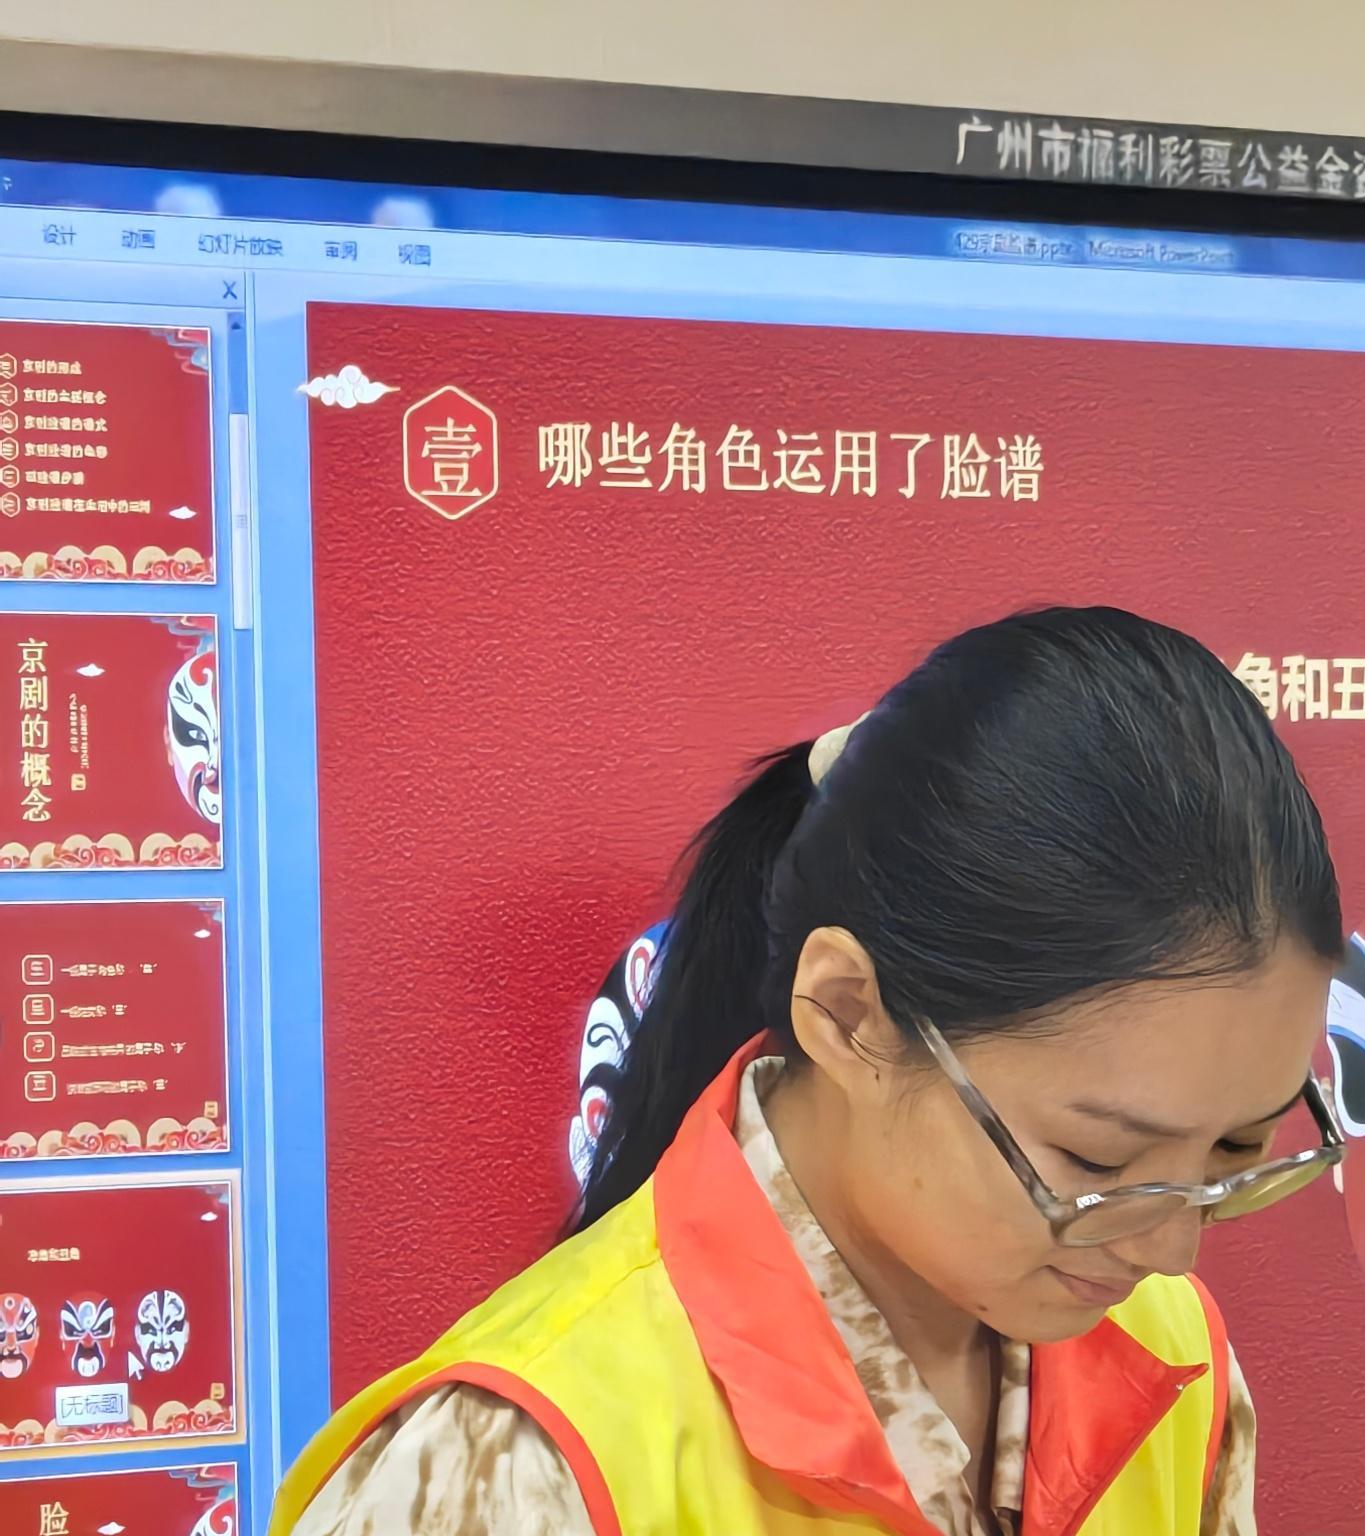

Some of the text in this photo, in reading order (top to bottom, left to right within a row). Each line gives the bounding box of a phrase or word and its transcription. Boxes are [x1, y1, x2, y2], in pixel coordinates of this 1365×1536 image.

[420, 416, 483, 499] 壹
[538, 420, 1046, 503] 哪些角色运用了脸谱
[17, 637, 52, 822] 京剧的概念
